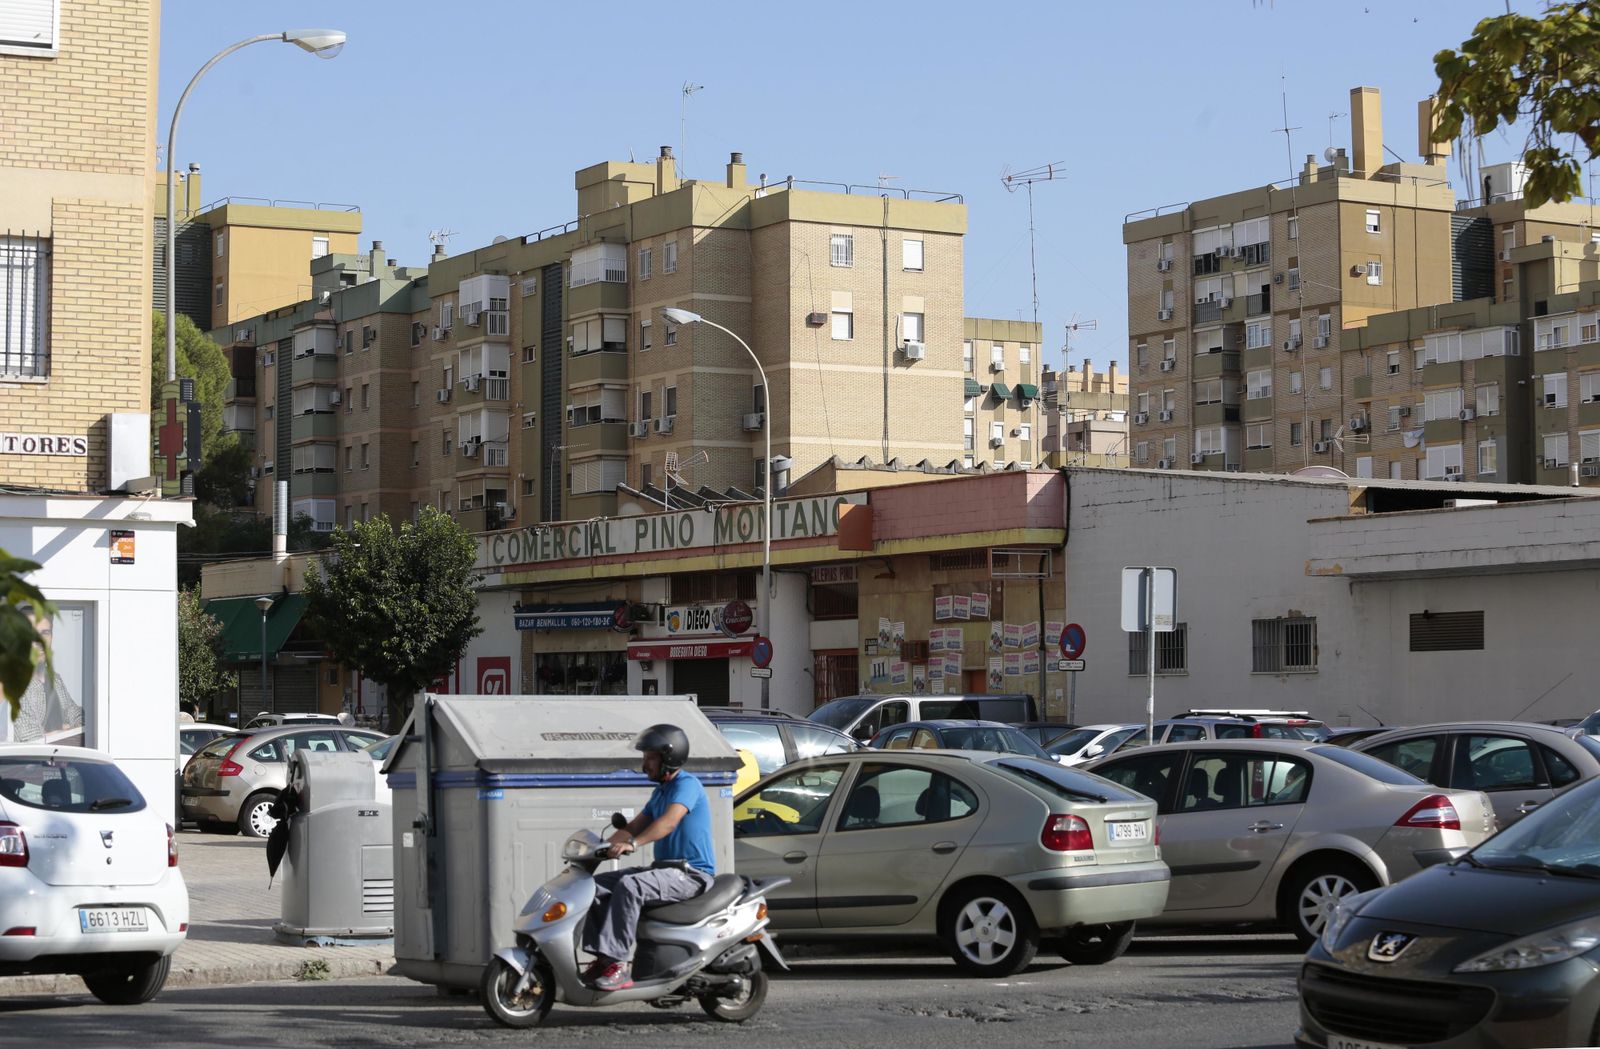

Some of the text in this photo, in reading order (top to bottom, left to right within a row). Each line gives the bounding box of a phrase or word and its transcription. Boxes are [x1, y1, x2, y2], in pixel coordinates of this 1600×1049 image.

[5, 436, 87, 454] TORES
[492, 521, 617, 564] COMERCIAL
[635, 513, 694, 551] PINO
[519, 617, 534, 628] BAZAR
[687, 609, 711, 631] DIEGO
[694, 644, 708, 657] DIEGO
[88, 911, 145, 927] 6613 HZL
